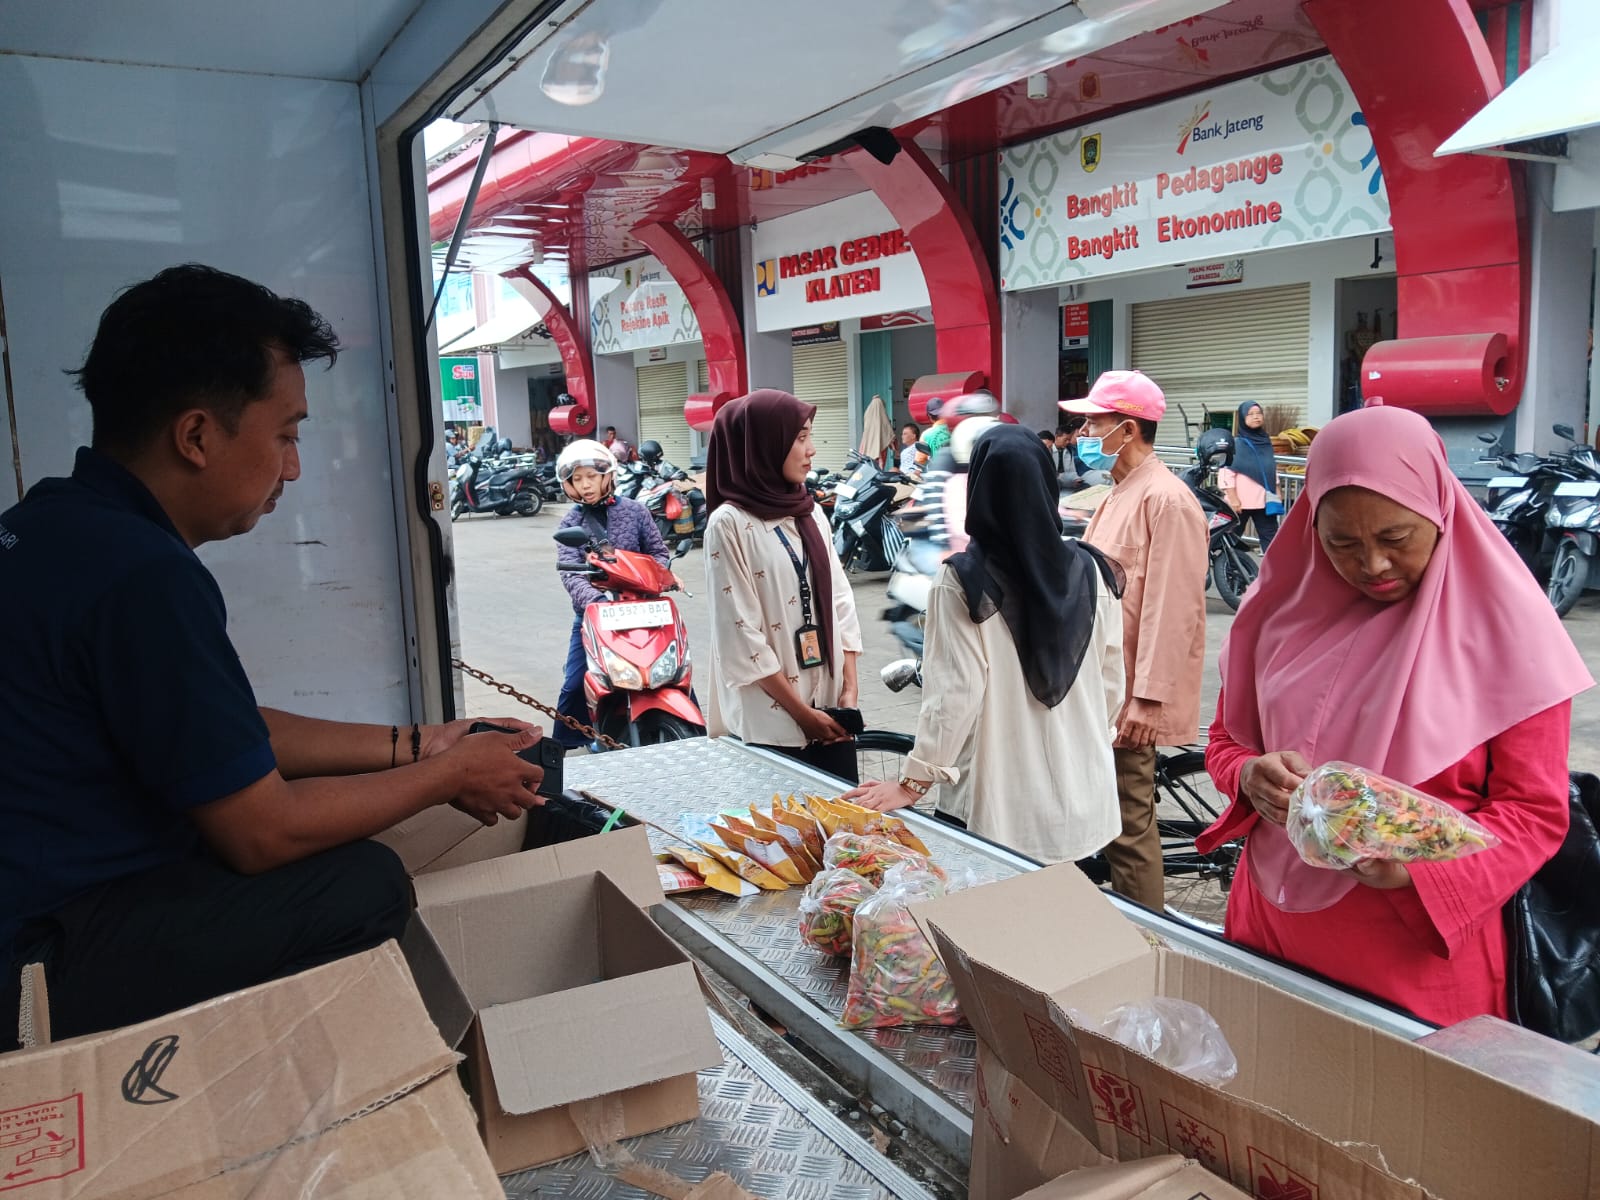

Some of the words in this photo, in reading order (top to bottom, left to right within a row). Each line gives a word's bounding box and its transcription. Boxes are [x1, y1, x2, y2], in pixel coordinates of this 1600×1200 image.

[1193, 122, 1222, 142] Bank
[1223, 114, 1264, 139] Jateng
[1066, 181, 1138, 219] Bangkit
[1156, 152, 1283, 199] Pedagange
[1067, 225, 1139, 260] Bangkit
[1157, 200, 1282, 243] Ekonomine
[779, 246, 837, 279] PASAR
[806, 267, 880, 303] KLATEN
[646, 292, 668, 310] Resik
[652, 311, 670, 329] Apik
[602, 607, 616, 618] AD
[648, 602, 669, 614] BAC
[16, 1113, 64, 1127] TERIMA
[24, 1106, 57, 1117] JUAL
